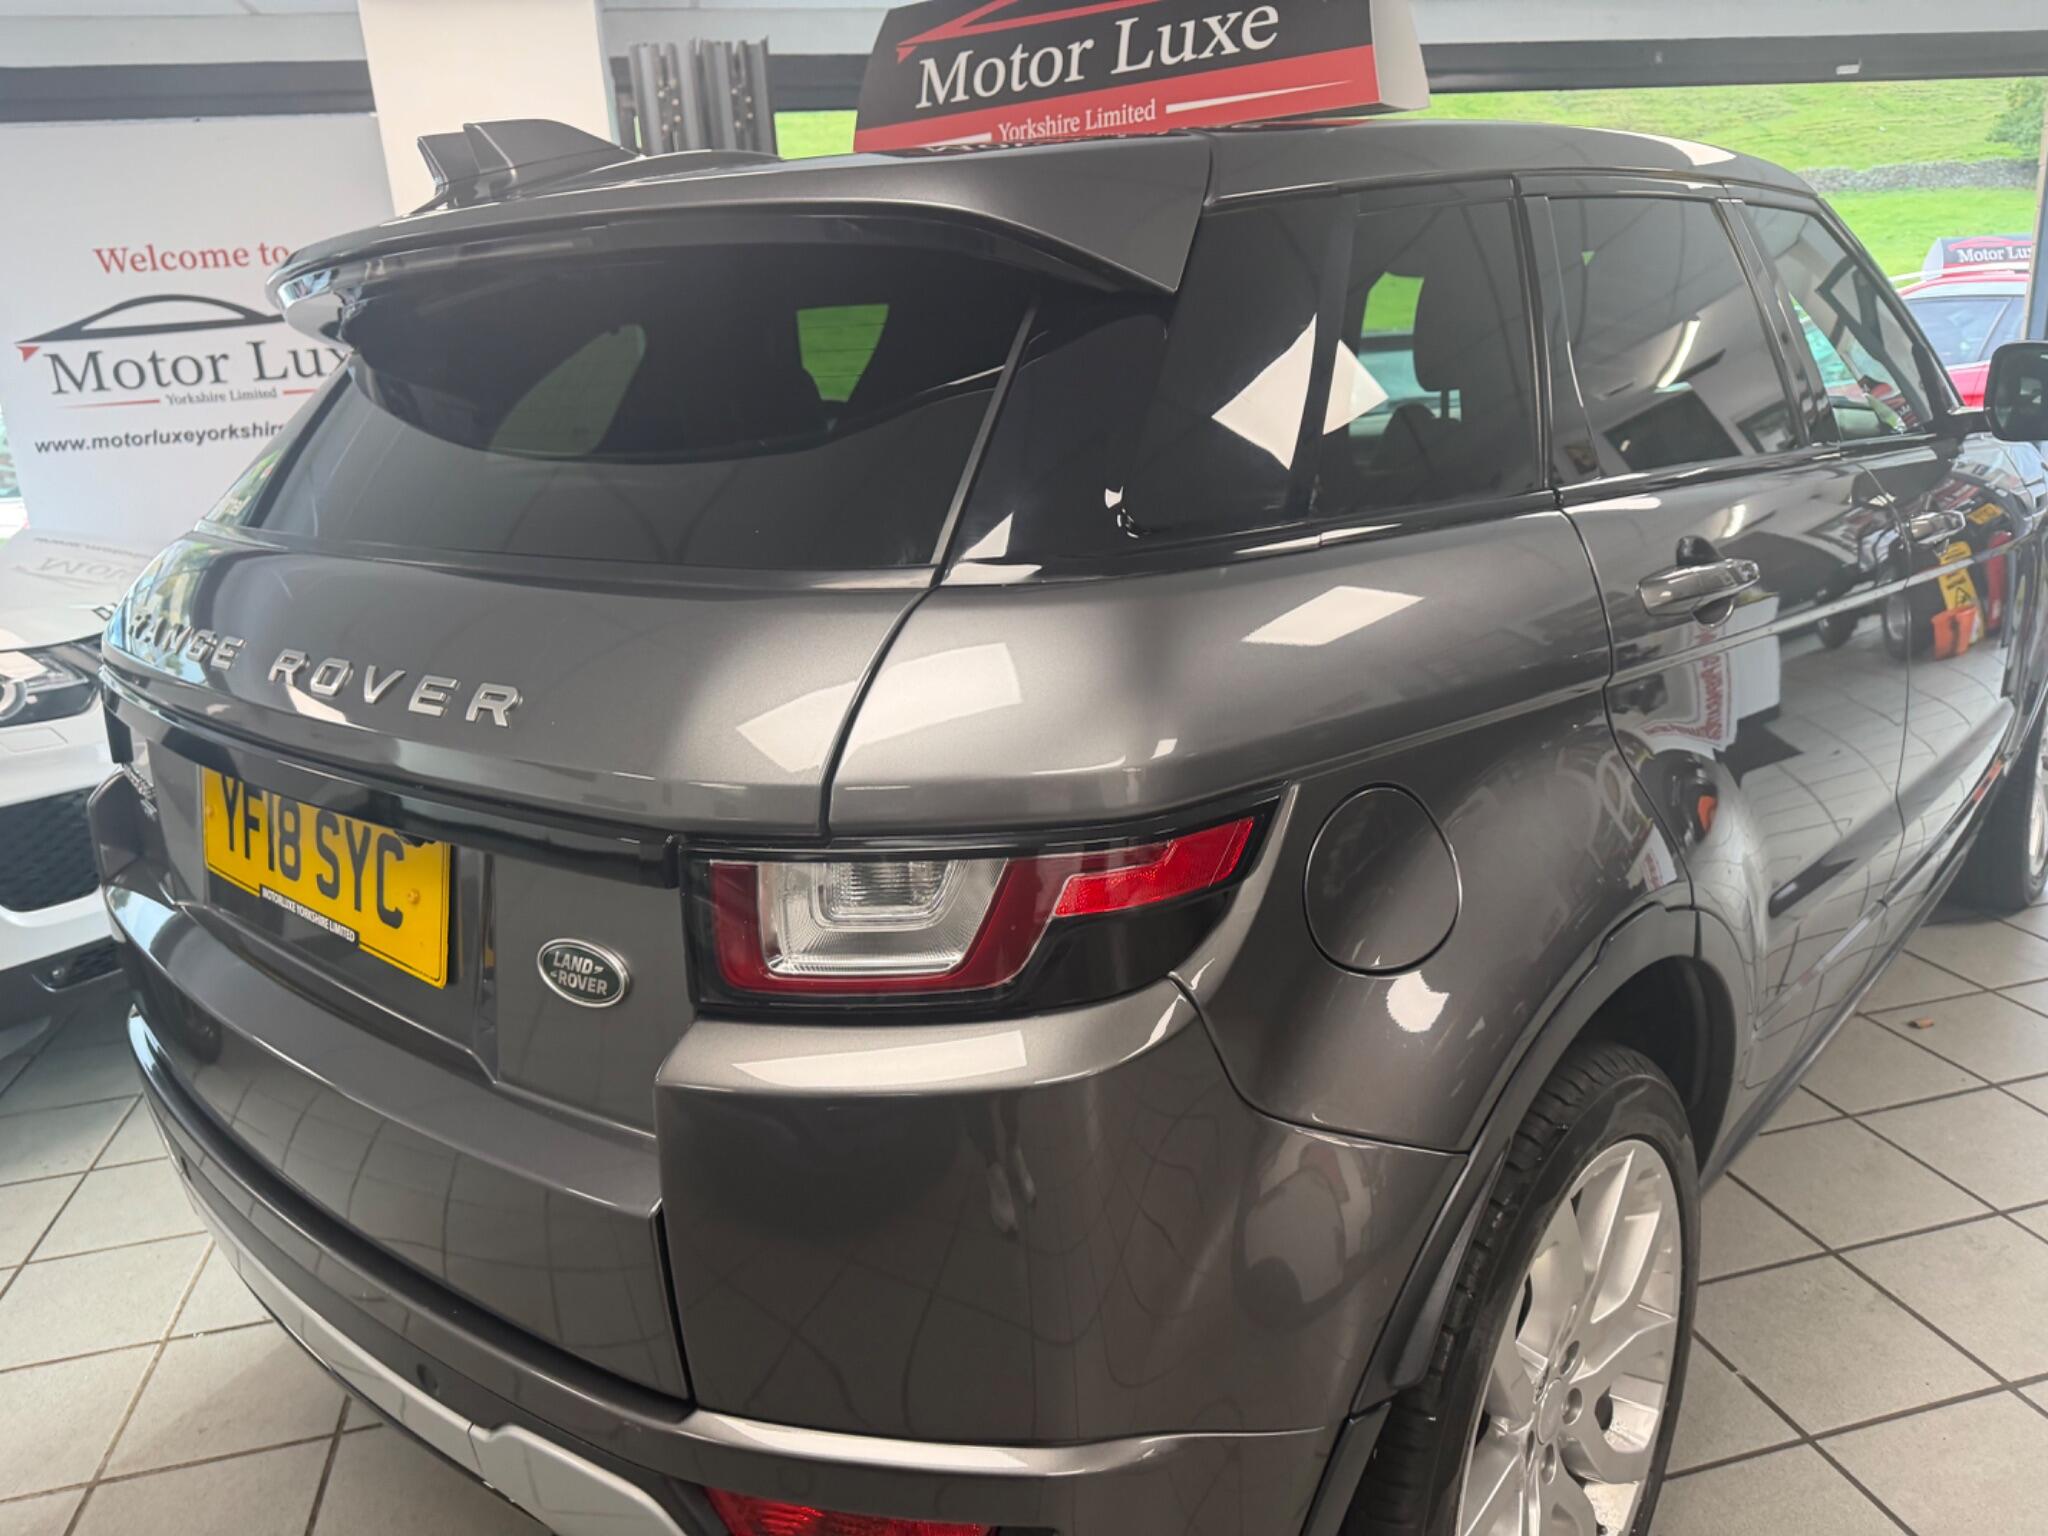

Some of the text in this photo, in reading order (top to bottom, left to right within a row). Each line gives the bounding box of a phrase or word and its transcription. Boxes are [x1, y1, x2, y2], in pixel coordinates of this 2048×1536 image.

[916, 5, 1279, 109] Motor Luxe
[998, 99, 1157, 141] Yorkshire Limited
[92, 242, 290, 274] Welcome to
[1957, 247, 2005, 263] Motor
[43, 339, 349, 395] Motor Lux
[165, 387, 278, 406] Yorkshire Limited
[34, 421, 284, 453] www.motorluxeyorkshir
[128, 613, 523, 728] RANGE ROVER
[222, 773, 301, 882] YF18
[316, 808, 404, 930] SYC
[329, 919, 355, 943] LIMITED
[553, 950, 594, 975] LAND
[558, 970, 608, 996] ROVER
